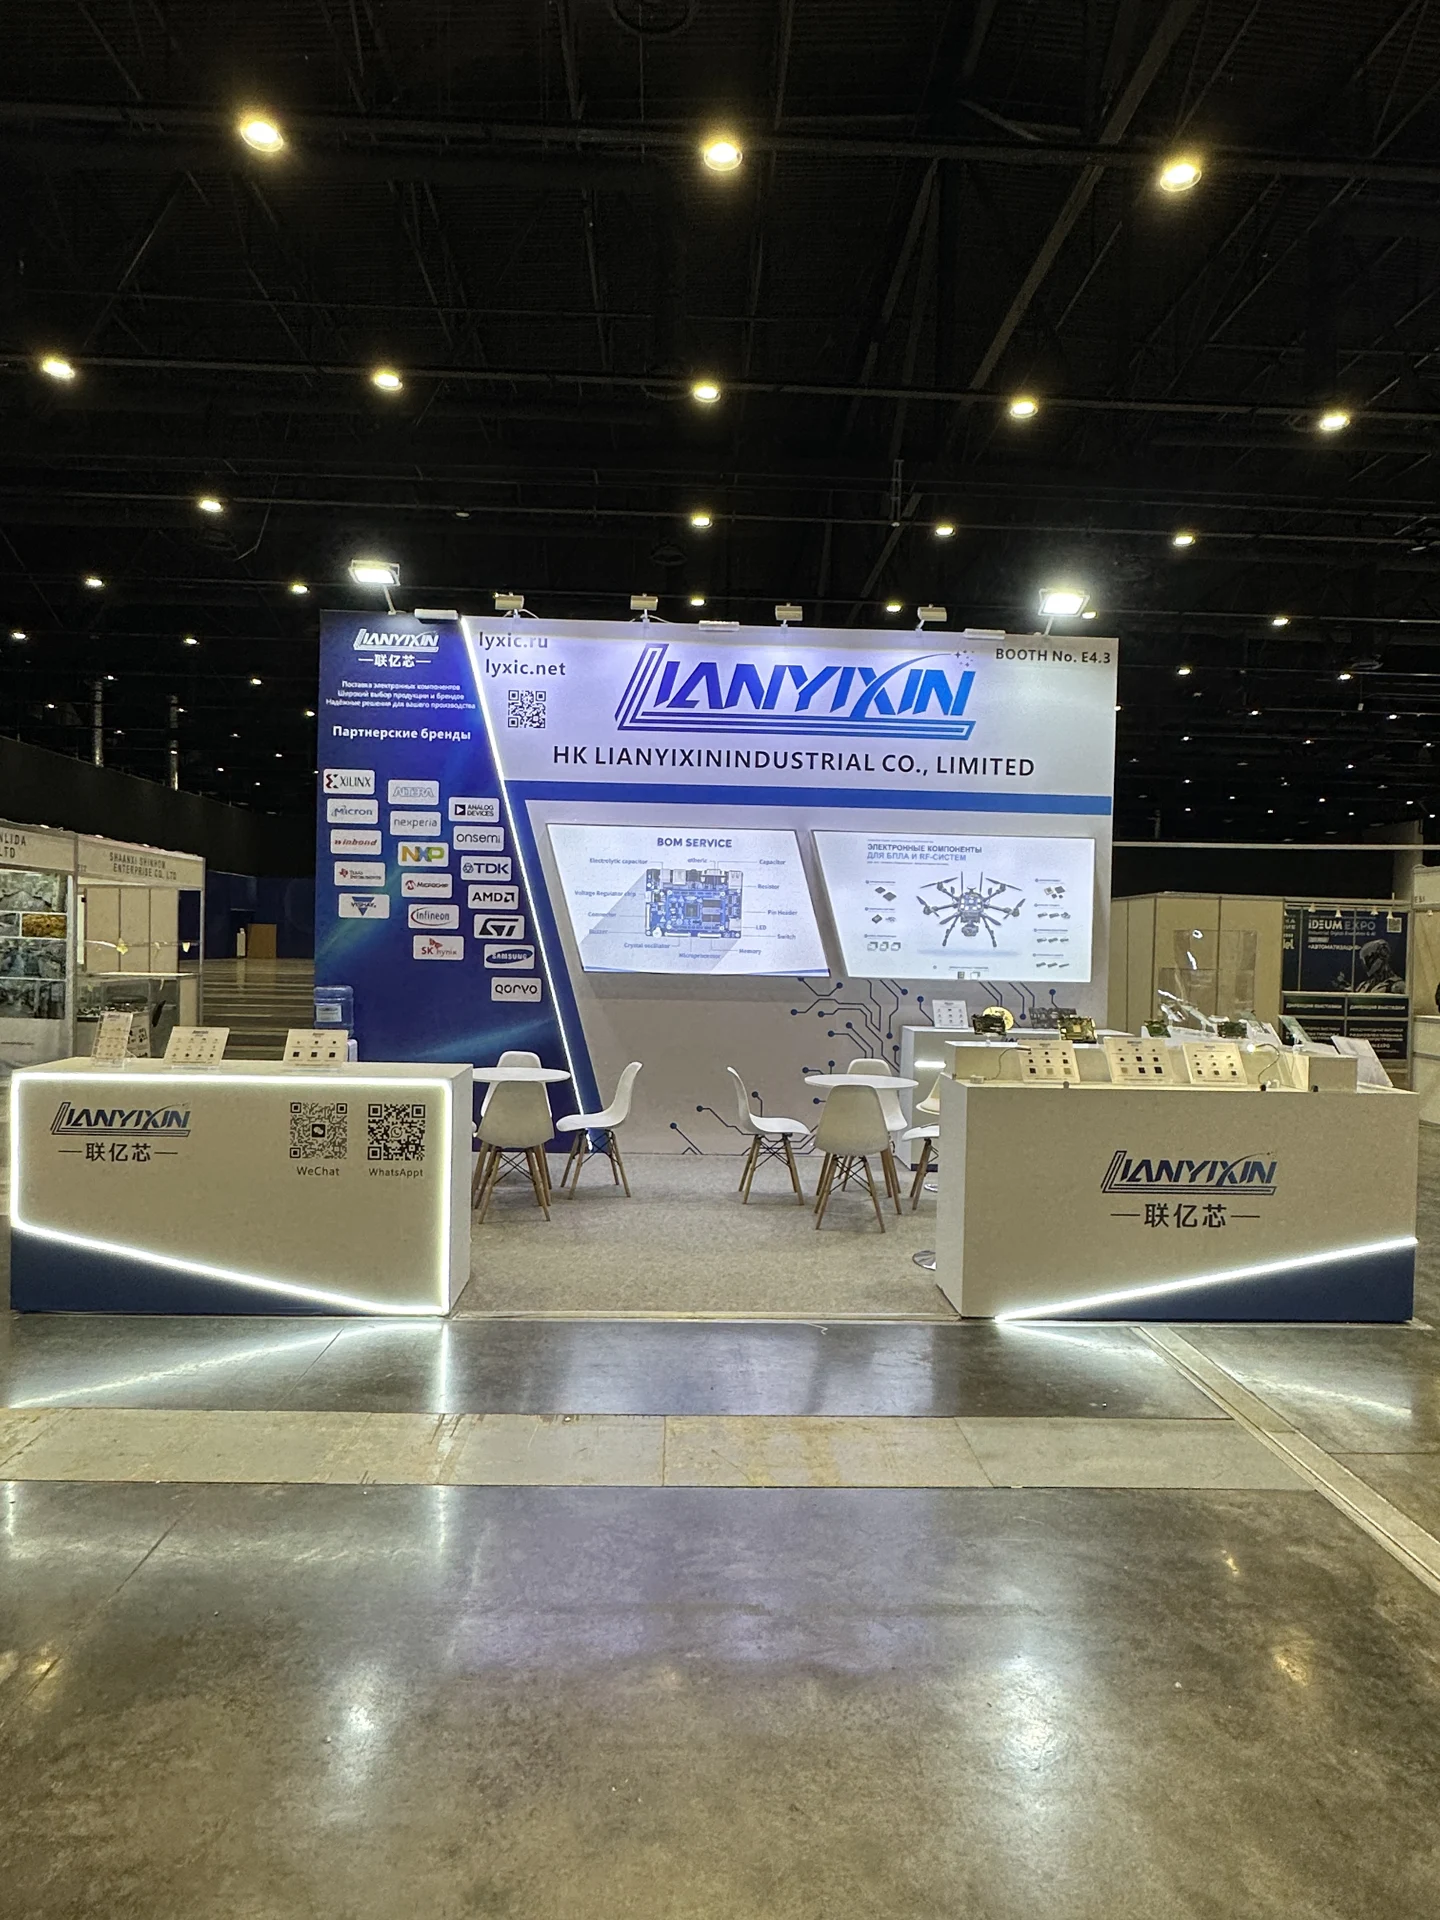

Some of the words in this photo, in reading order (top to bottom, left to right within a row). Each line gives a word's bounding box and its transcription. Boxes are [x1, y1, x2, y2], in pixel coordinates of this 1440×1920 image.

[478, 631, 548, 650] lyxic.ru
[373, 654, 416, 668] 联亿芯
[996, 648, 1048, 662] BOOTH
[1052, 651, 1078, 663] No.
[1081, 651, 1111, 664] E4.3
[485, 659, 566, 678] lyxic.net
[342, 680, 372, 689] Поставка
[614, 643, 976, 741] LIANYIXIN
[333, 725, 418, 740] Партнерские
[420, 727, 471, 741] бренды
[553, 746, 587, 765] HK
[595, 747, 875, 771] LIANYIXININDUSTRIAL
[882, 754, 929, 775] CO.,
[937, 756, 1035, 776] LIMITED
[339, 775, 371, 788] XILINX
[392, 786, 435, 798] ALTERA
[393, 817, 438, 829] nexperia
[334, 838, 378, 847] winbond
[456, 833, 501, 844] onsemi
[657, 837, 683, 847] BOM
[686, 838, 733, 848] SERVICE
[0, 846, 16, 858] TD
[402, 845, 444, 863] NXP
[867, 843, 926, 852] ЭЛЕКТРОННЫЕ
[927, 845, 982, 853] КОМПОНЕНТЫ
[866, 851, 885, 860] ДЛЯ
[886, 852, 910, 860] БПЛА
[113, 863, 152, 877] ENTERPRISE
[474, 862, 509, 875] TDK
[472, 892, 503, 902] AMD
[1344, 920, 1376, 931] EXPO
[421, 946, 434, 955] SK
[436, 947, 457, 958] hynix
[491, 952, 528, 961] SAMSUNG
[50, 1101, 191, 1138] LIANYIXIN
[85, 1142, 152, 1163] 联亿芯
[296, 1165, 340, 1177] WeChat
[368, 1166, 424, 1179] WhatsAppt
[1101, 1150, 1278, 1196] LIANYIXIN
[1144, 1203, 1228, 1229] 联亿芯
